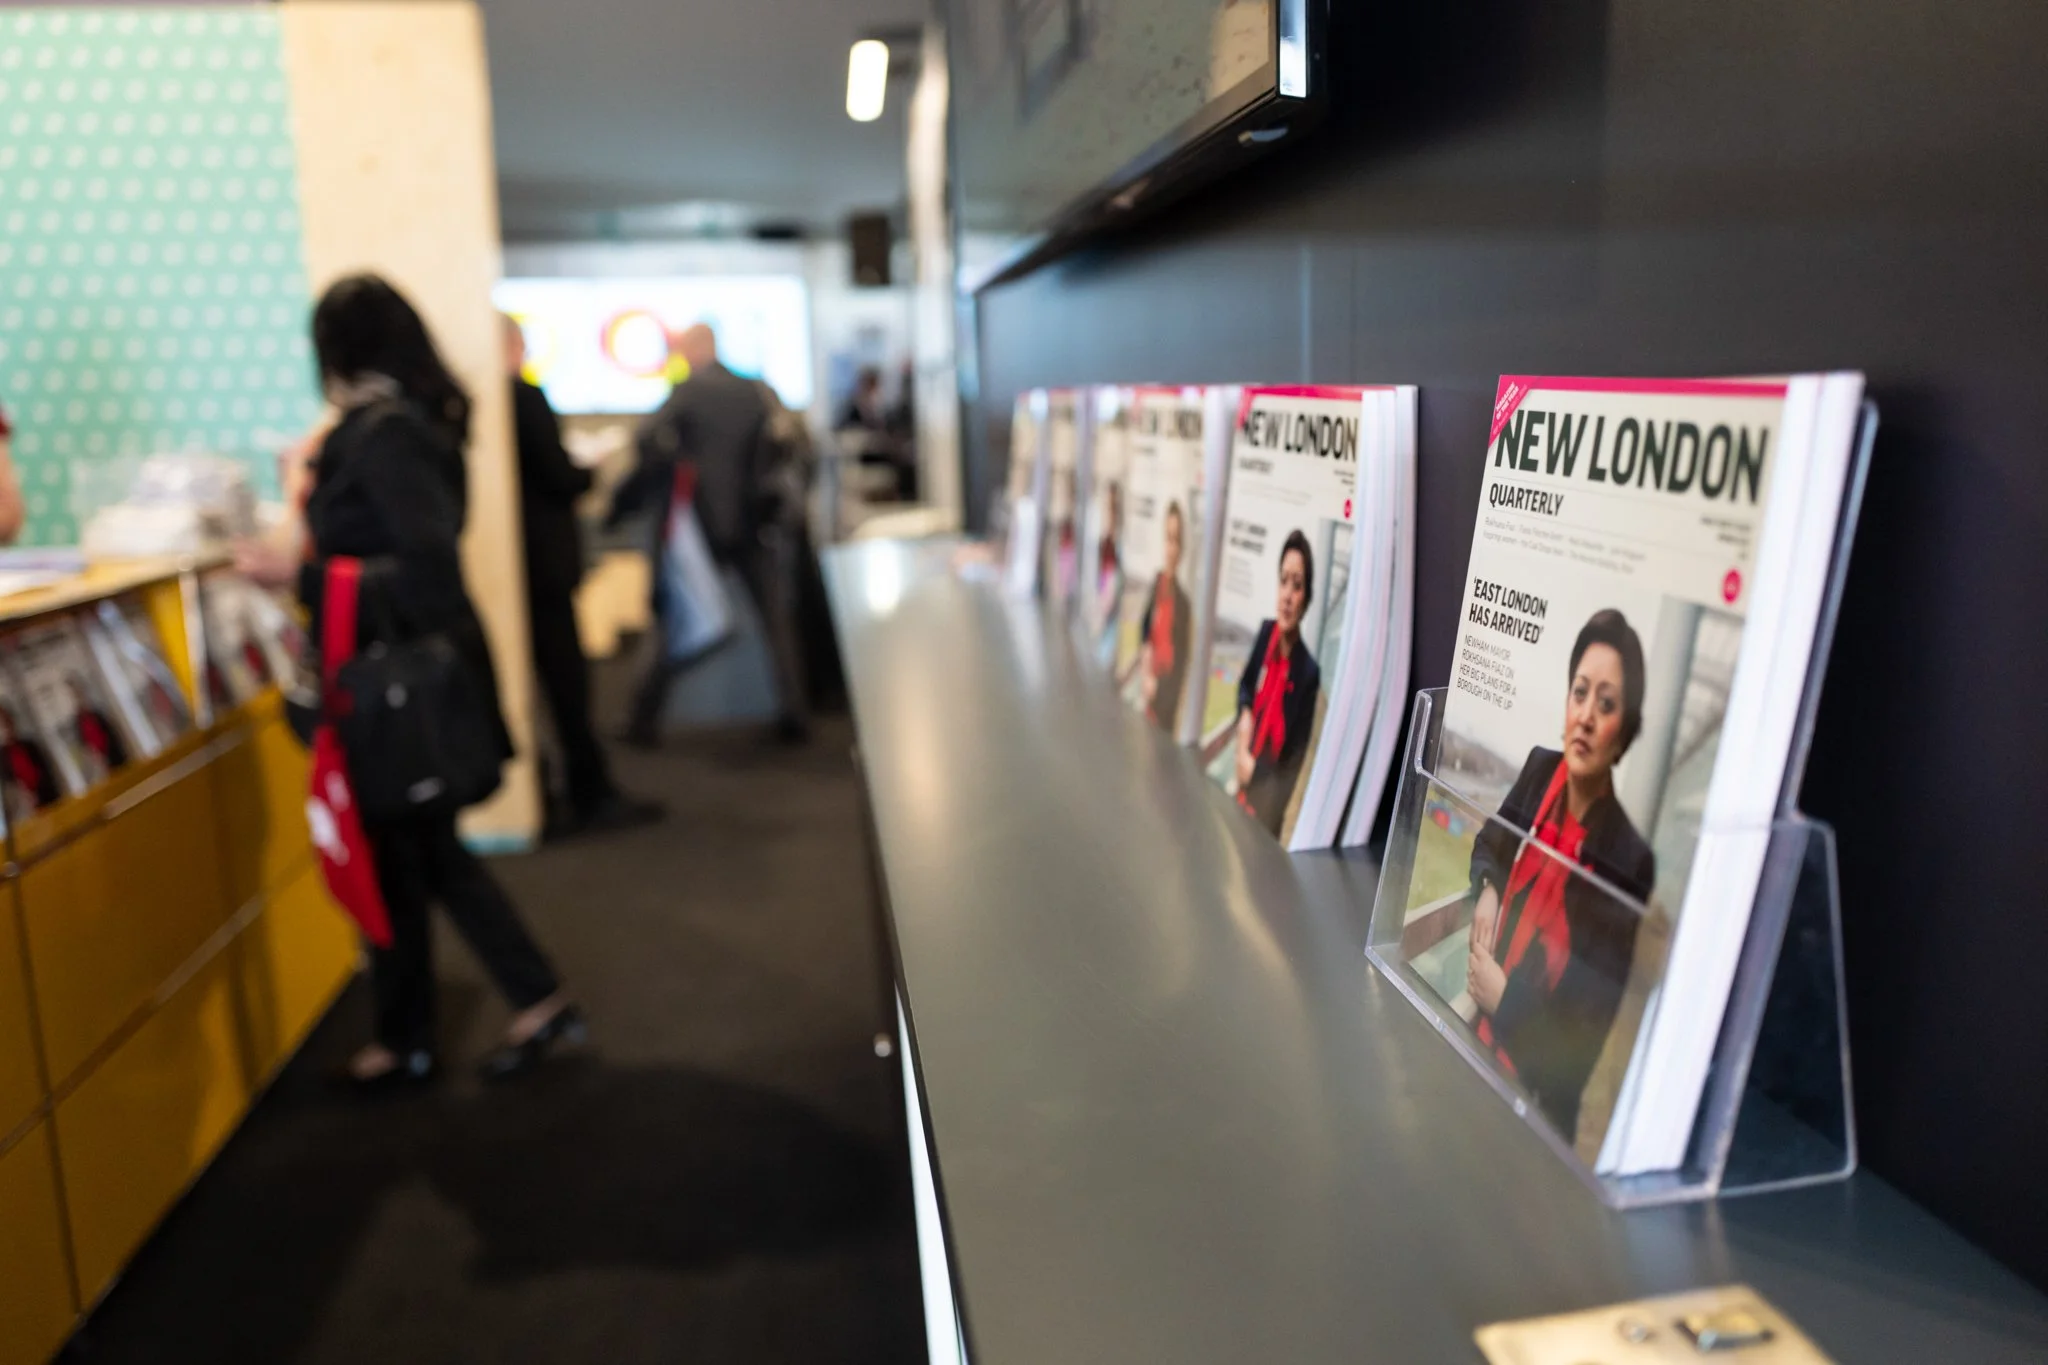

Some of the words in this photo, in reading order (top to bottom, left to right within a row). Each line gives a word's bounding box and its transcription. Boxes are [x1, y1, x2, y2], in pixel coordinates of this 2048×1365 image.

[1285, 412, 1358, 462] LONDON
[1494, 409, 1588, 478] NEW
[1587, 415, 1769, 506] LONDON
[1489, 483, 1564, 516] QUARTERLY
[1469, 603, 1490, 627] HAS
[1501, 587, 1548, 619] LONDON
[1464, 634, 1490, 653] NEWHAM
[1461, 648, 1491, 669] ROKHSANA
[1504, 667, 1514, 679] ON
[1457, 677, 1483, 698] BOROUGH
[1482, 689, 1491, 702] ON
[1492, 692, 1503, 708] THE
[1503, 698, 1513, 710] UP
[1460, 664, 1470, 676] HER
[1470, 667, 1480, 681] BIG
[1479, 671, 1499, 689] PLANS
[1498, 680, 1511, 693] FOR
[1511, 686, 1517, 696] A
